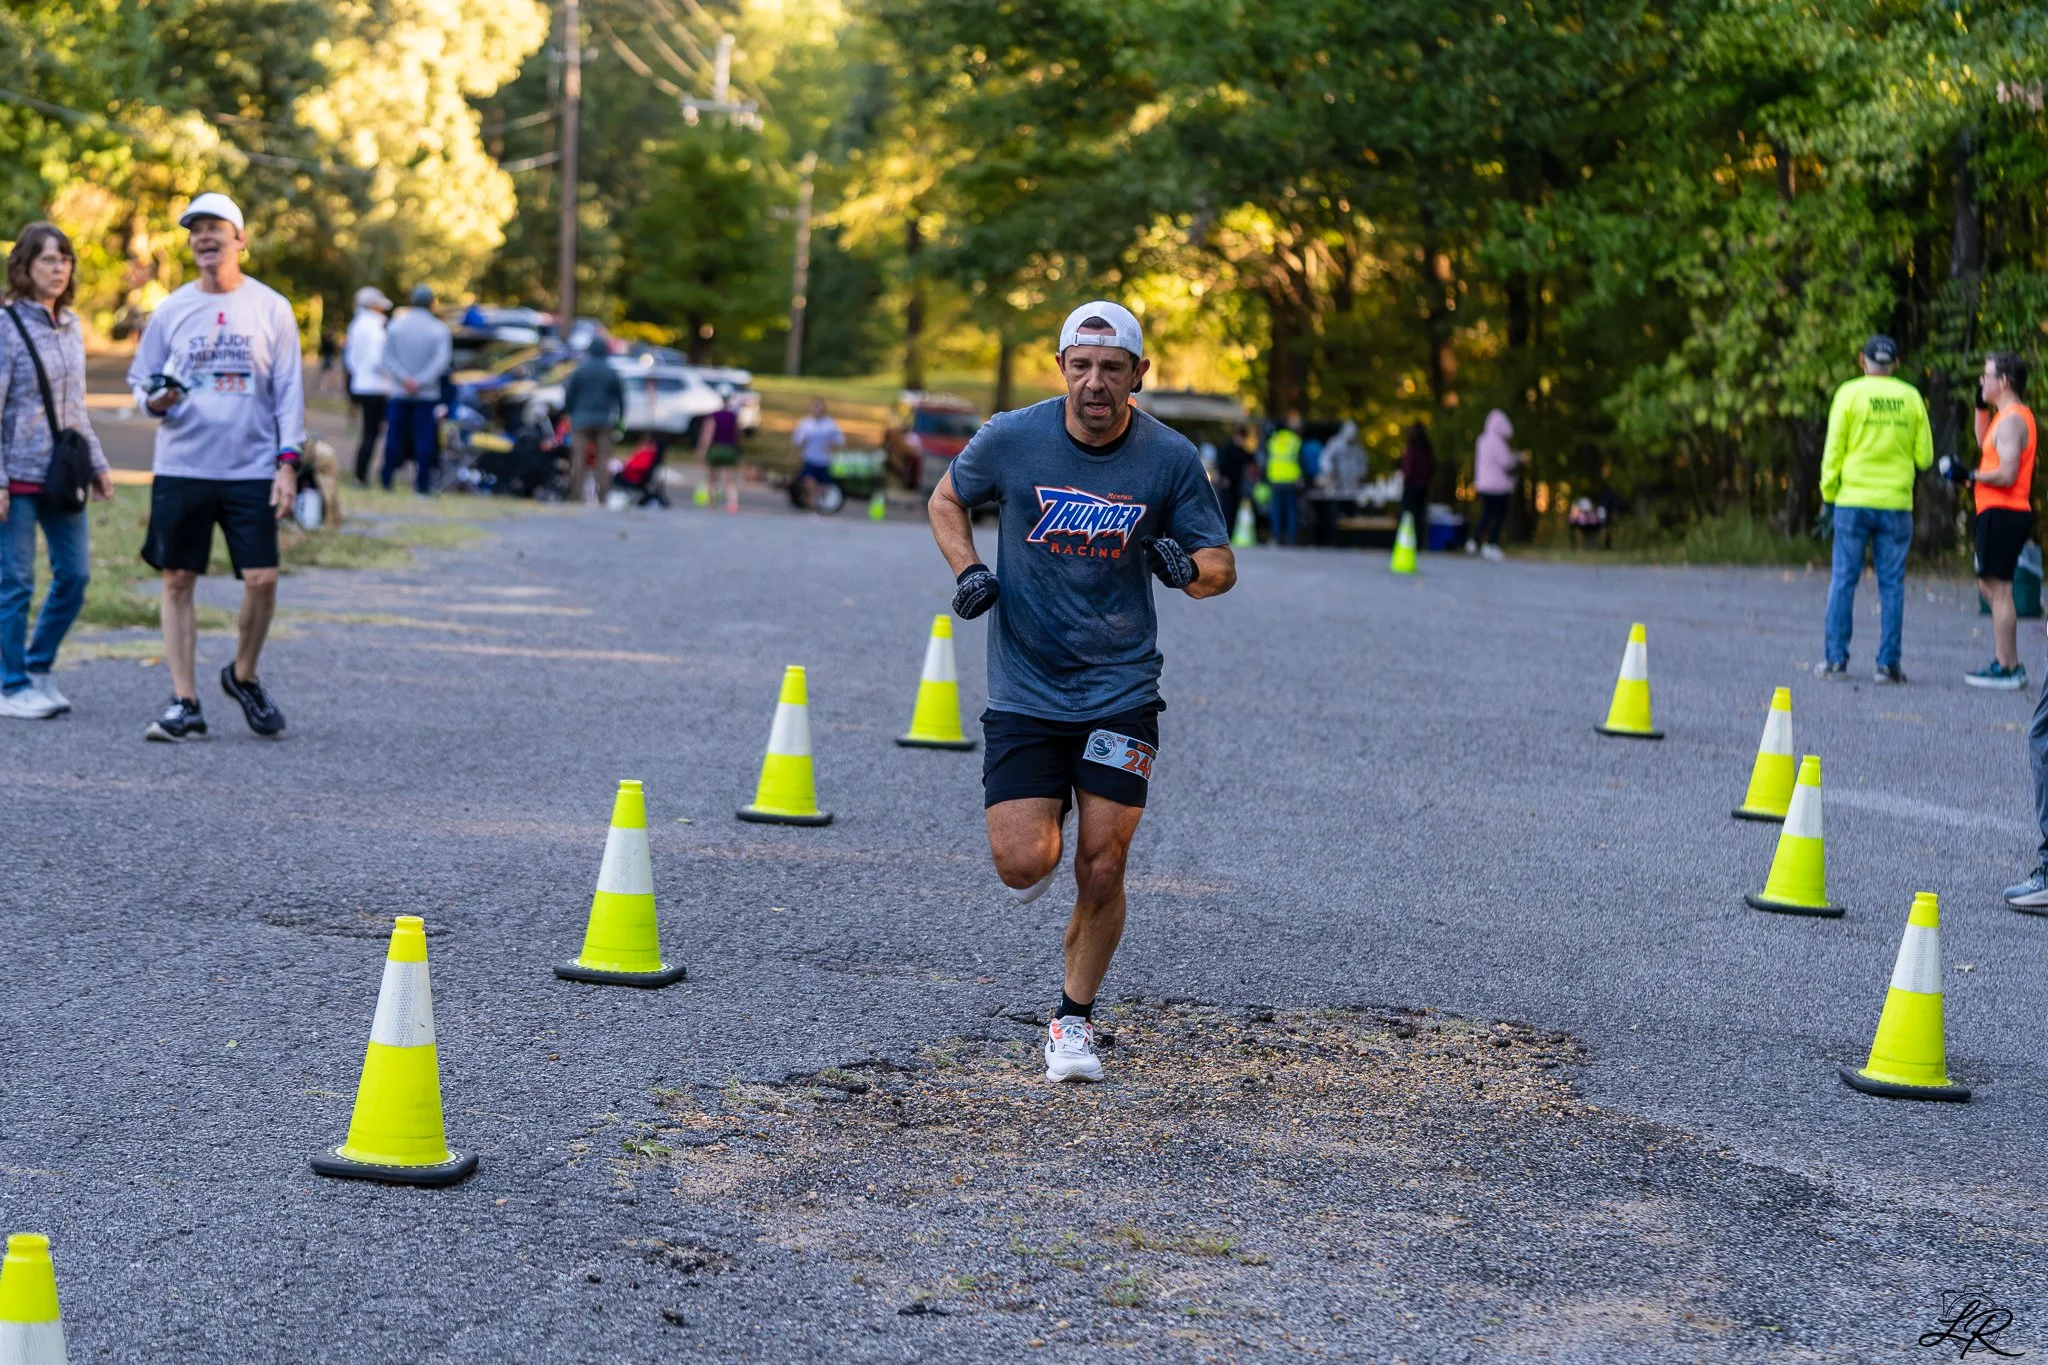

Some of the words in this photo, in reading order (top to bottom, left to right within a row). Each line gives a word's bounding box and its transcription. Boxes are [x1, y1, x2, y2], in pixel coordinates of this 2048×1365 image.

[189, 336, 210, 349] ST.
[215, 333, 254, 347] JUDE
[188, 350, 254, 362] MEMPHIS
[1027, 486, 1146, 550] THUNDER
[1050, 542, 1121, 559] RACING
